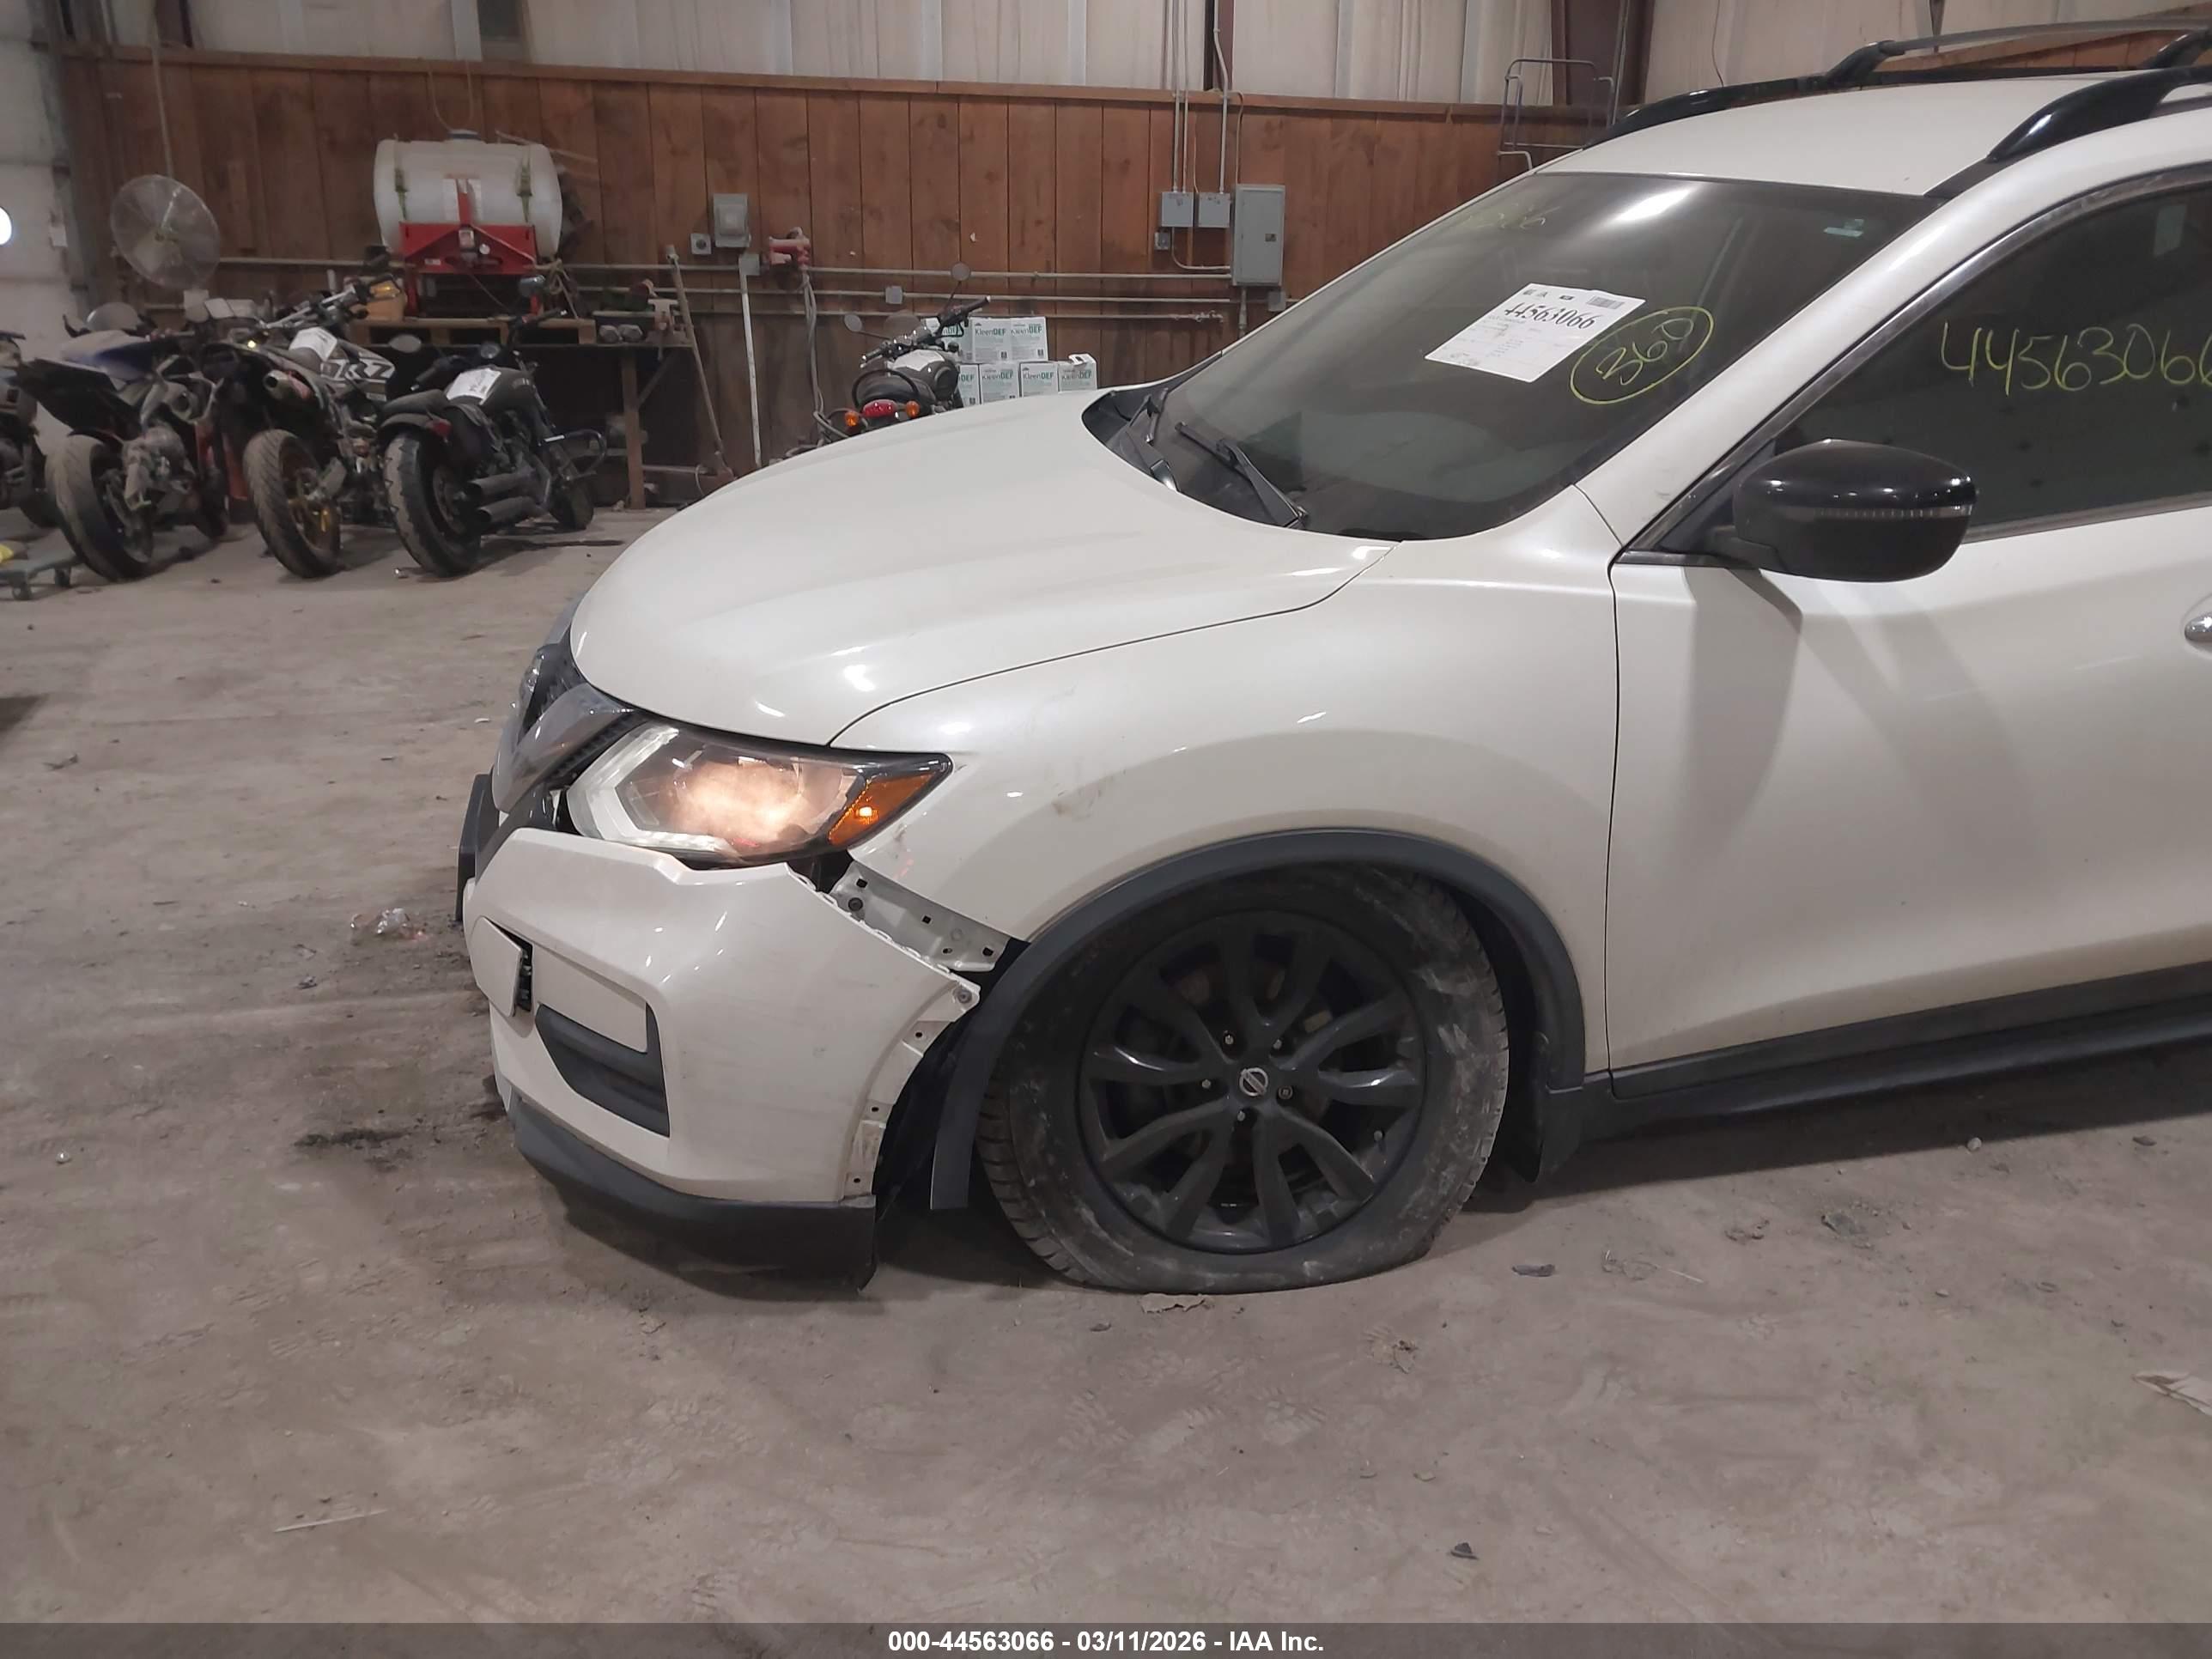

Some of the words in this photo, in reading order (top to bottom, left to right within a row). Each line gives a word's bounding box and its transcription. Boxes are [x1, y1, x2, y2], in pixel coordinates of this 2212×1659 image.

[1504, 302, 1602, 330] 44563066
[975, 327, 1006, 337] KleenDEF
[1011, 325, 1042, 336] KleenDEF
[981, 370, 1014, 380] KleenDEF
[1023, 371, 1054, 380] KleenDEF
